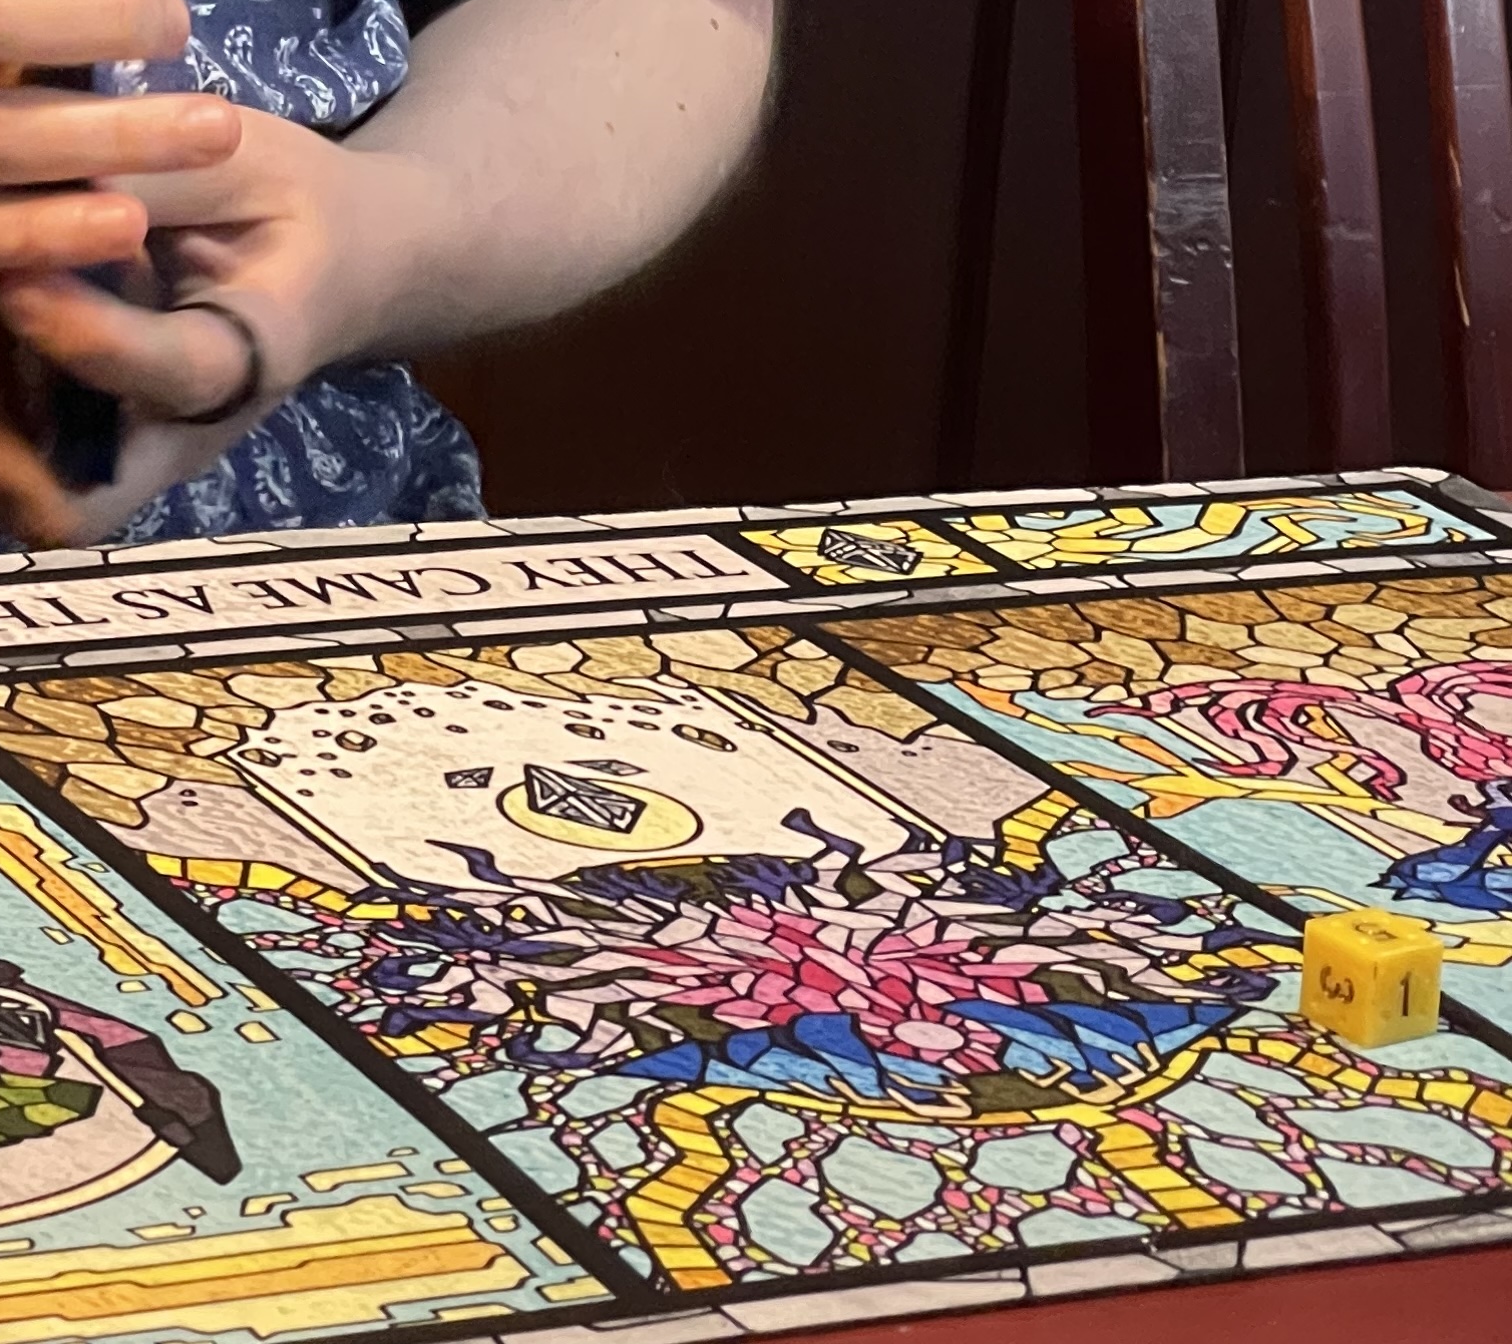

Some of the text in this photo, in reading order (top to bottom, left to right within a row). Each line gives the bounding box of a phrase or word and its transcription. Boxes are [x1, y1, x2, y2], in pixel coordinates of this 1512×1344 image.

[229, 567, 492, 610] CAME
[503, 549, 750, 591] THEY
[111, 584, 217, 620] AS
[1319, 965, 1355, 1005] 3
[1399, 970, 1412, 1017] 1
